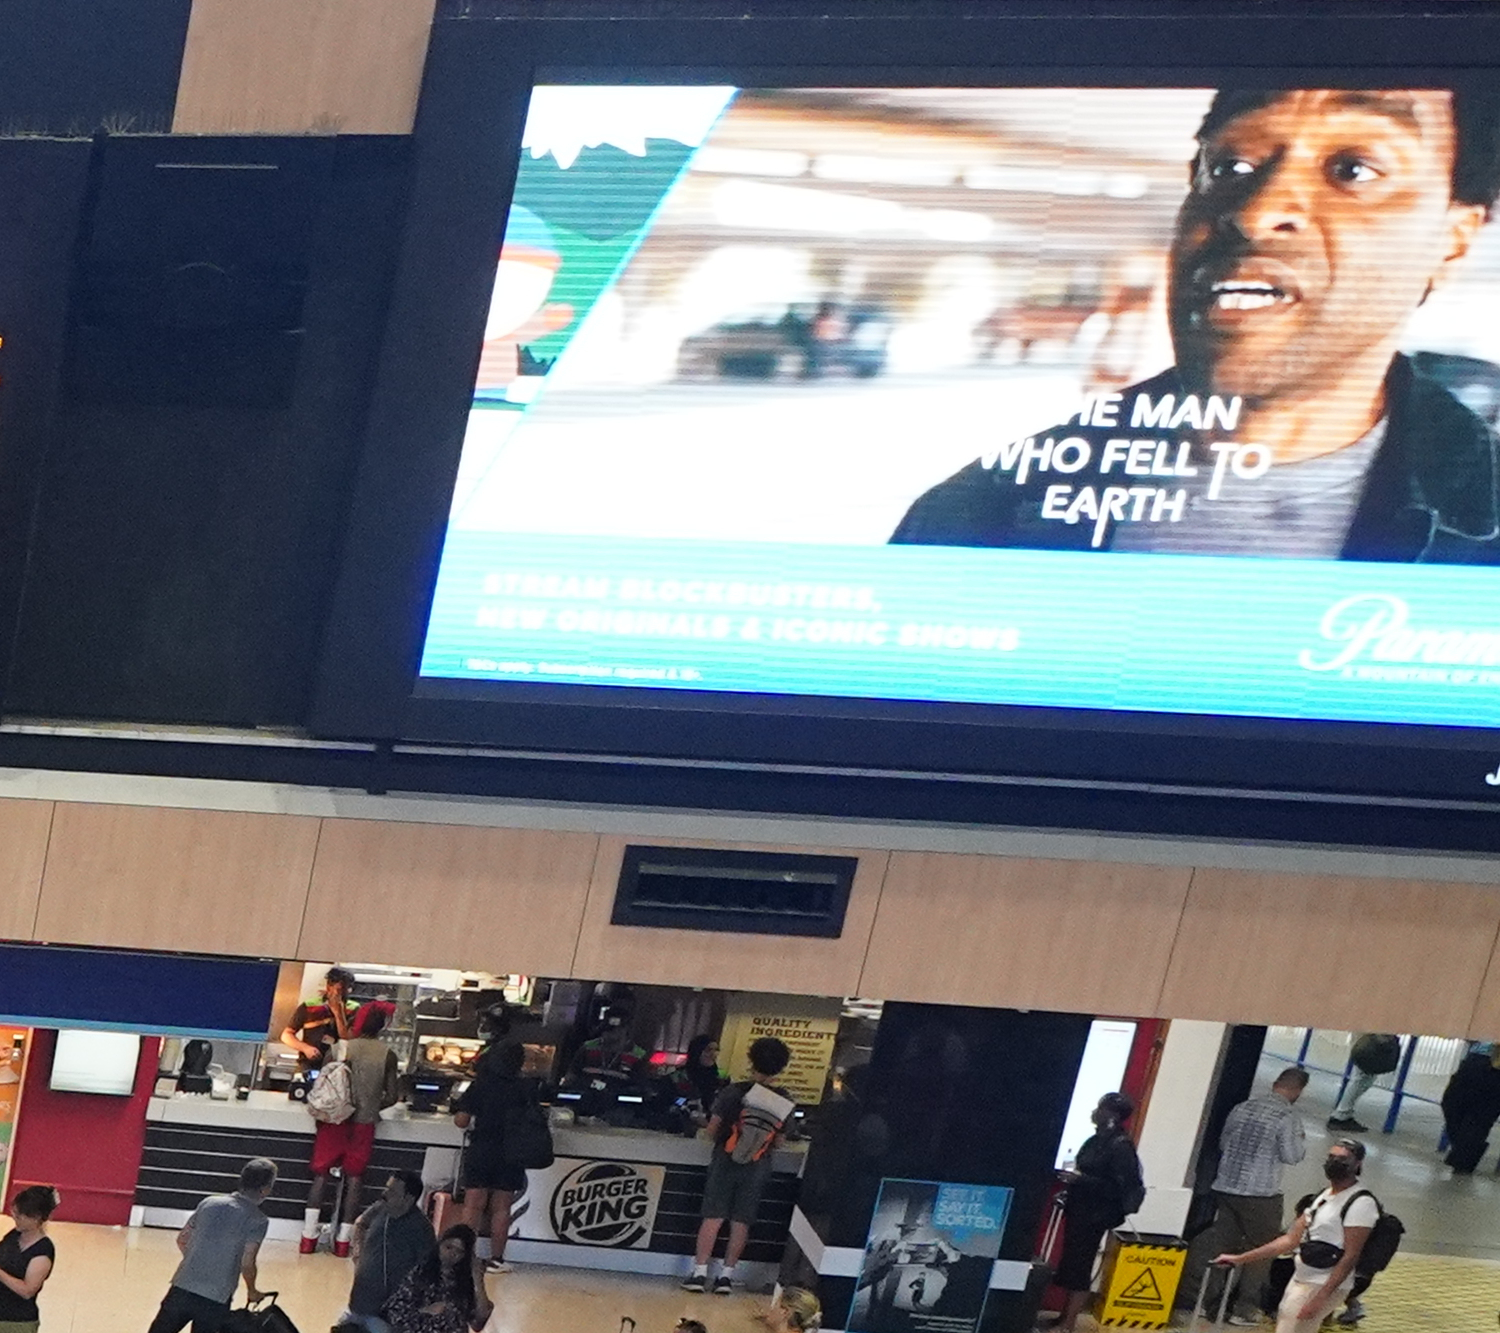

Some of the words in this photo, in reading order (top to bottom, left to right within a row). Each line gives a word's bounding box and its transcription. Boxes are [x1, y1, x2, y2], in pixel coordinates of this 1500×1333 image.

[1132, 394, 1240, 431] MAN
[980, 437, 1092, 486] WHO
[1100, 438, 1196, 477] FELL
[1208, 443, 1272, 499] TO
[1041, 486, 1185, 546] EARTH
[752, 1017, 812, 1029] QUALITY
[561, 1178, 648, 1208] BURGER
[559, 1195, 649, 1230] KING
[1125, 1255, 1177, 1267] CAUTION
